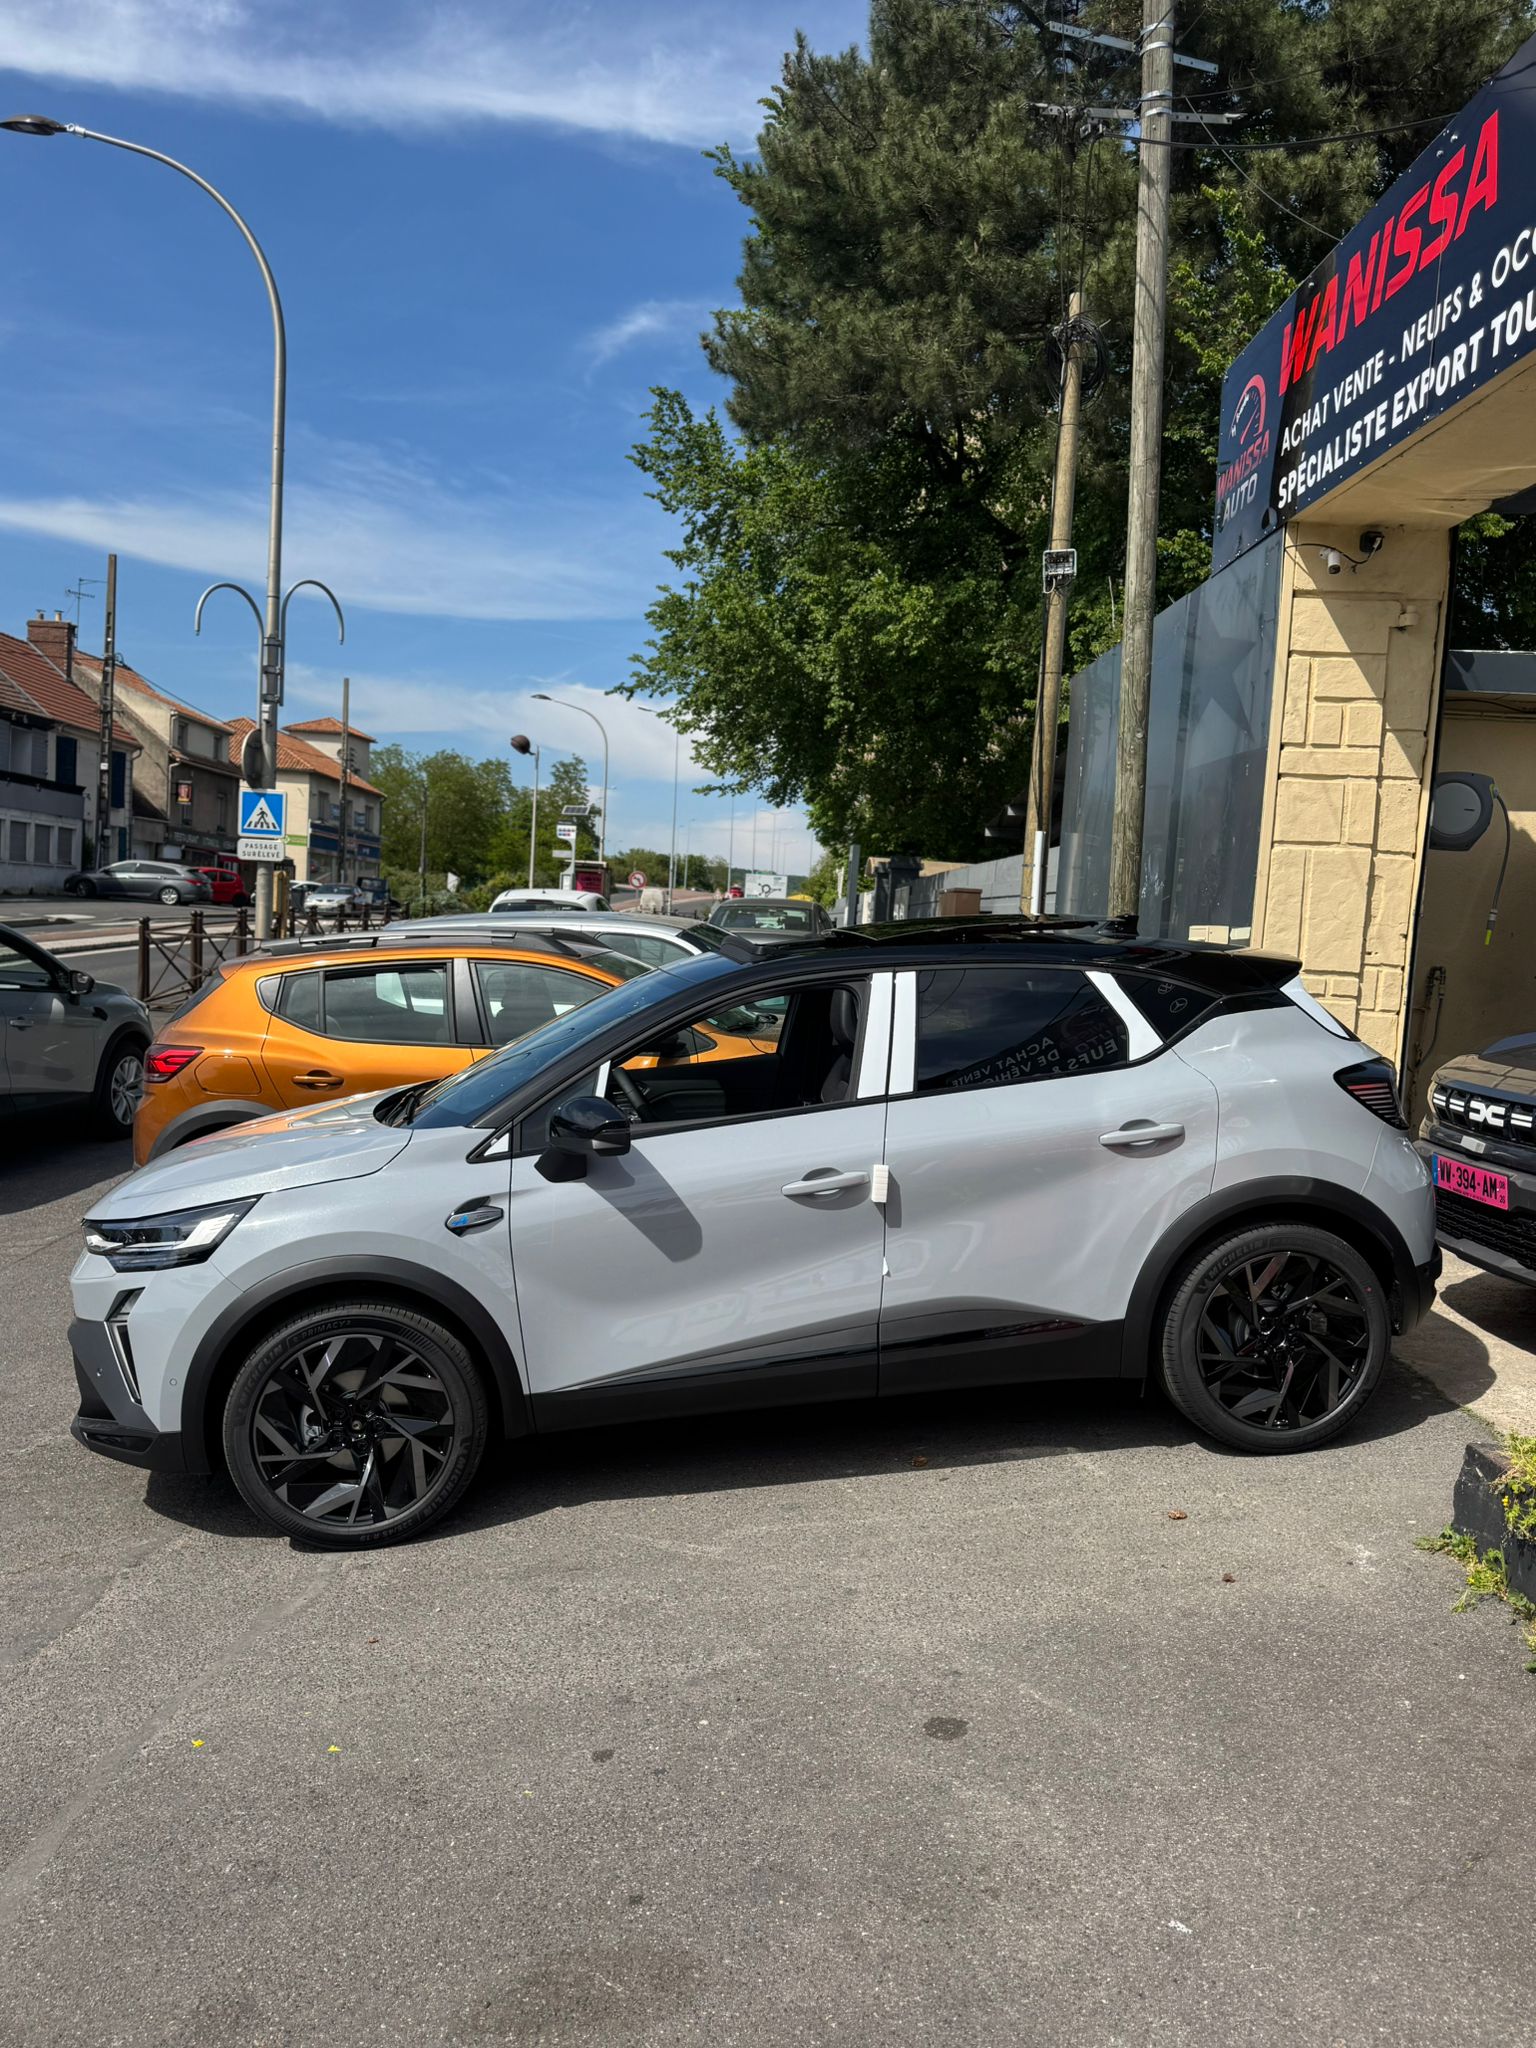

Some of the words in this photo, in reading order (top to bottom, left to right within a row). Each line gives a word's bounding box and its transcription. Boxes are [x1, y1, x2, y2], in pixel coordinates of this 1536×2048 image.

[1278, 111, 1499, 396] WANISSA
[1280, 393, 1331, 456] ACHAT
[1333, 349, 1384, 414] VENTE
[1401, 285, 1463, 363] NEUFS
[1468, 271, 1483, 309] &
[1491, 227, 1536, 289] OC
[1217, 429, 1270, 499] WANISSA
[1278, 400, 1388, 509] SPÉCIALISTE
[1391, 327, 1485, 430] EXPORT
[1222, 472, 1259, 527] AUTO
[244, 842, 279, 850] PASSAGE
